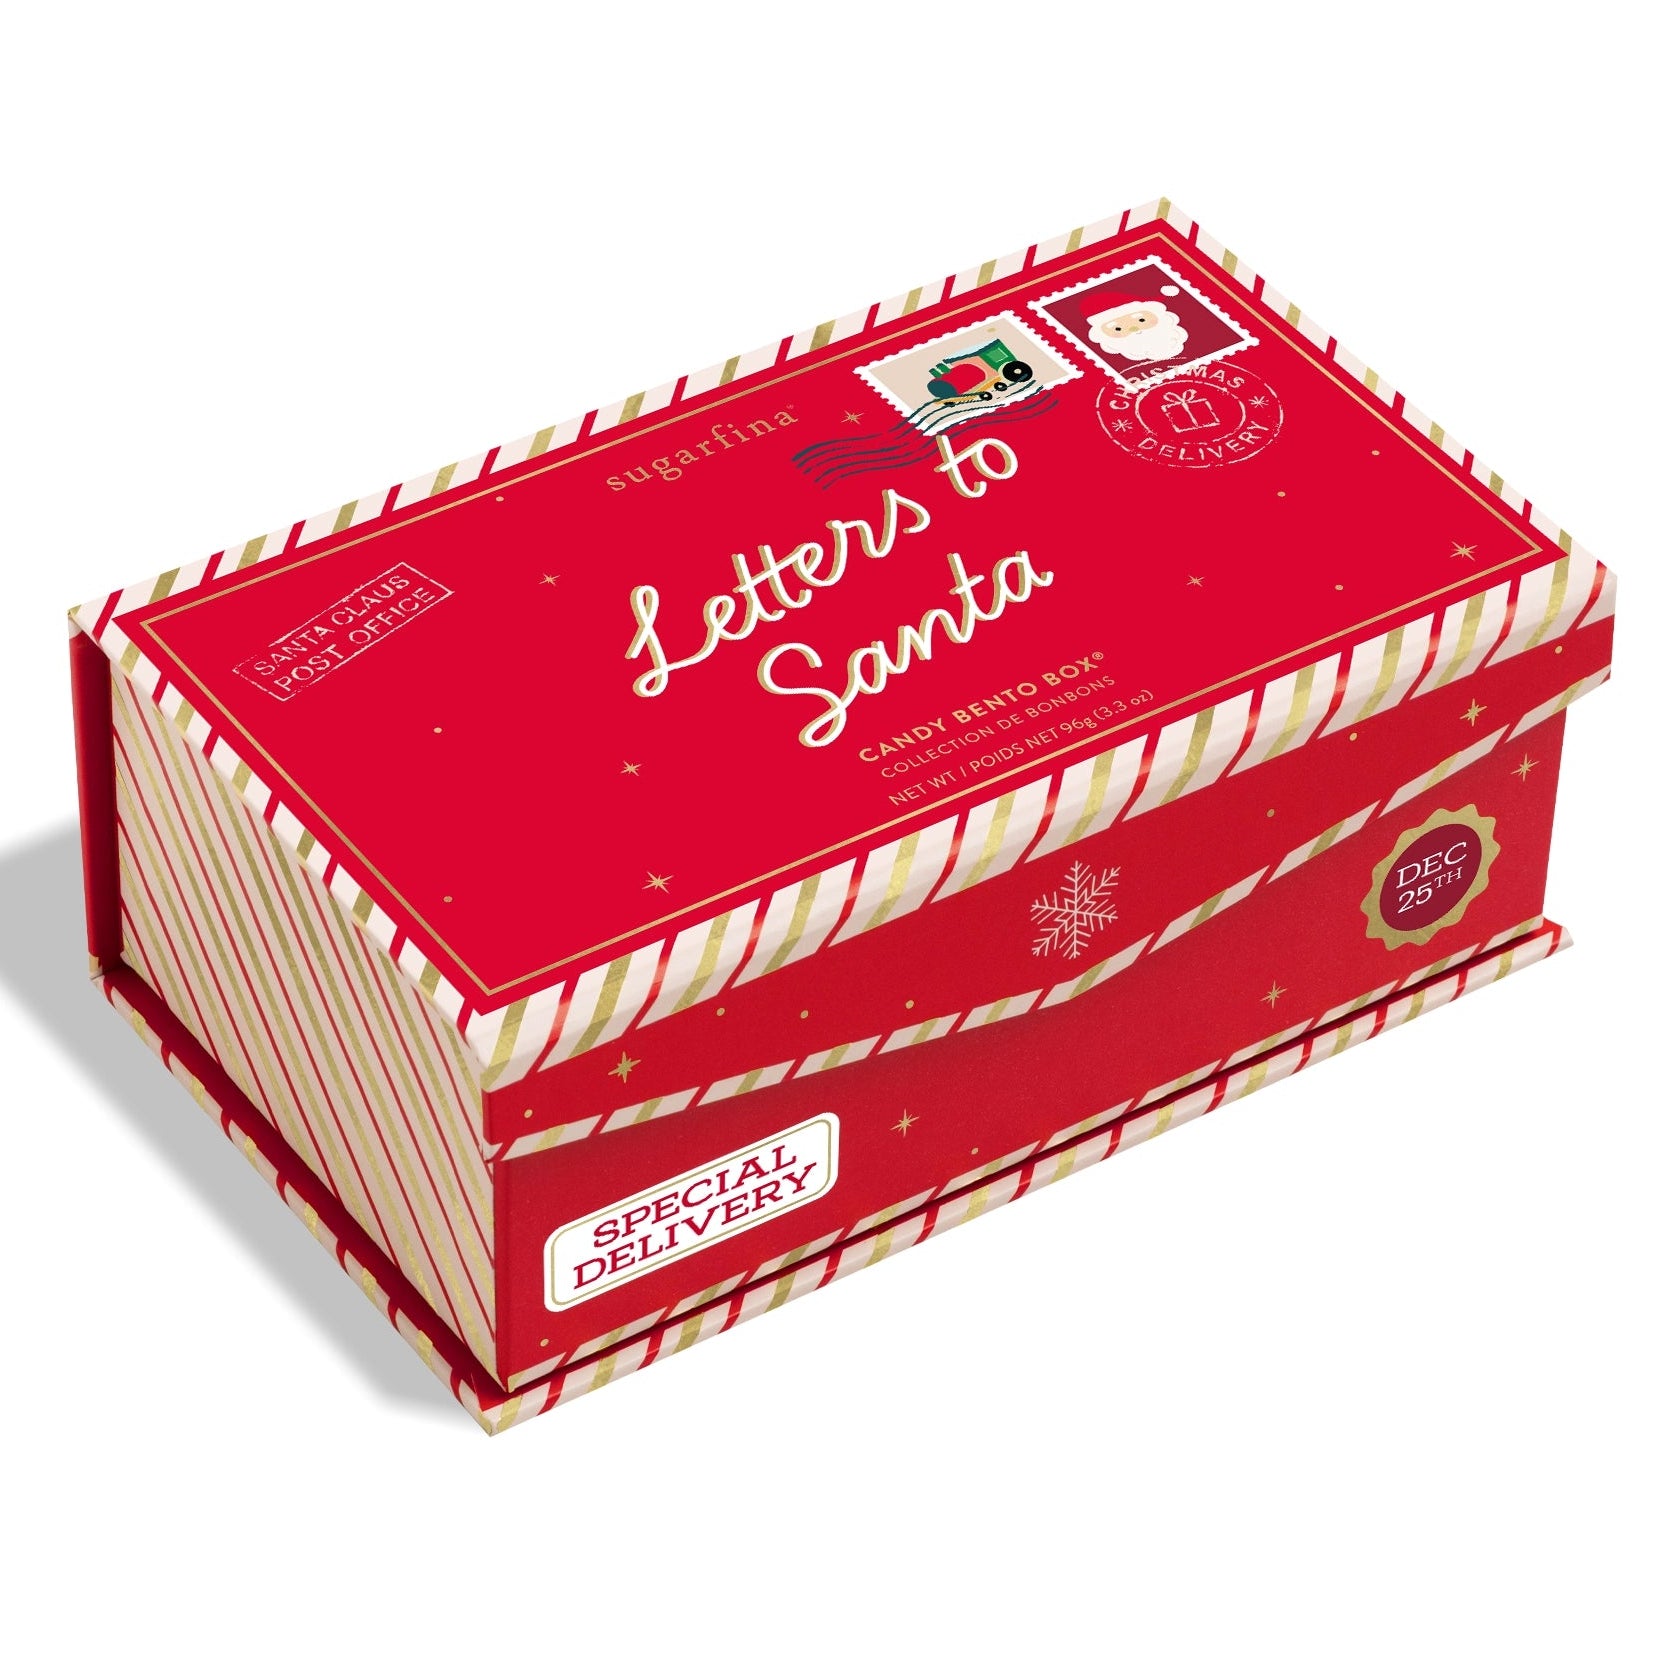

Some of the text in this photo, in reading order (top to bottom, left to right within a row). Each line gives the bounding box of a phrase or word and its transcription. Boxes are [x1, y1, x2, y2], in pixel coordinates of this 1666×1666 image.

[1138, 420, 1269, 461] DELIVERY
[625, 434, 1018, 697] Letters to
[253, 575, 410, 676] SANTA CLAUS
[273, 587, 436, 692] POST OFFICE
[757, 551, 1054, 747] Santa
[858, 717, 947, 762] CANDY
[951, 682, 1037, 724] BENTO
[881, 675, 1116, 779] COLLECTION DE BONBONS
[888, 782, 929, 806] NET
[926, 770, 957, 791] WT
[969, 742, 1024, 774] POIDS
[1024, 727, 1060, 750] NET
[1060, 715, 1097, 735] 96g
[1092, 700, 1127, 722] (3.3
[1130, 689, 1154, 706] oz)
[1395, 841, 1467, 889] DEC
[573, 1162, 817, 1290] DELIVERY
[593, 1144, 797, 1249] SPECIAL
